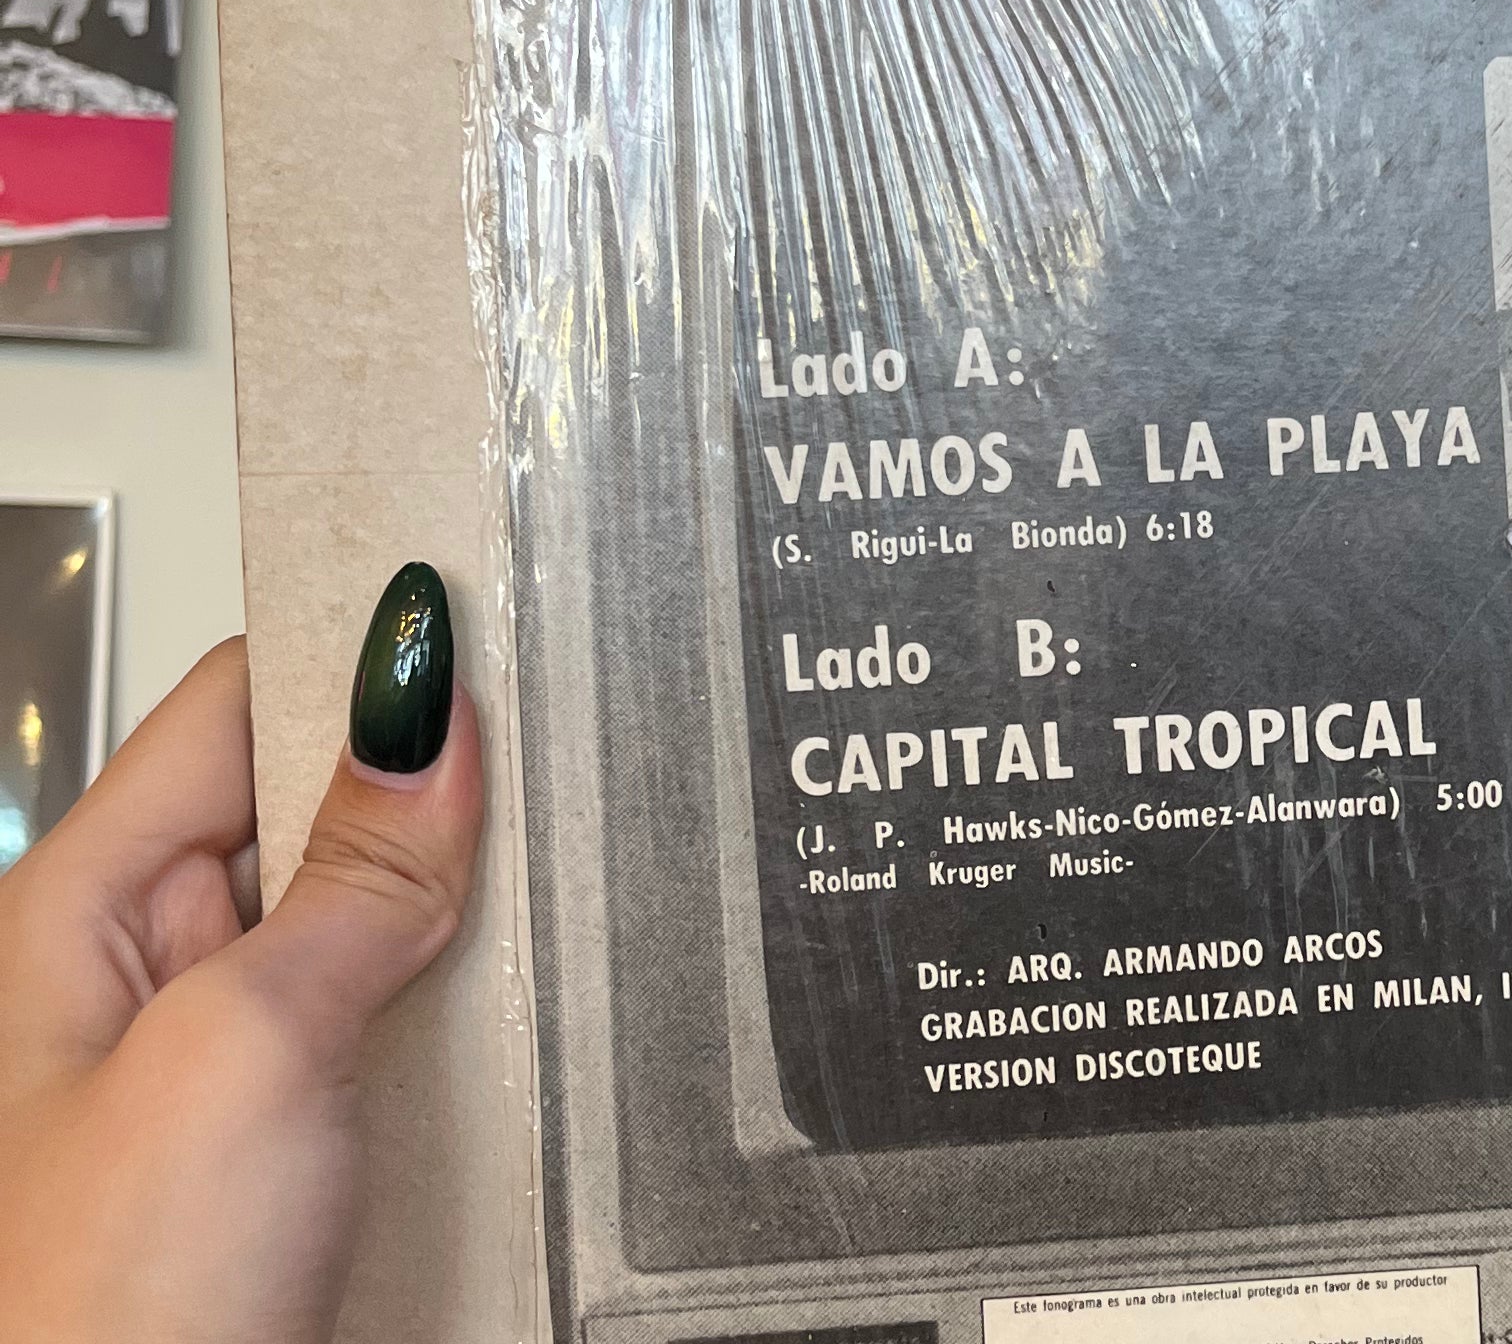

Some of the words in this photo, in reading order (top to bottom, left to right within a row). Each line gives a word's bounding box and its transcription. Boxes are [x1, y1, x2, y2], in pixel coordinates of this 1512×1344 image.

[757, 330, 907, 398] Lado
[954, 327, 1025, 388] A:
[763, 432, 1012, 504] VAMOS
[1057, 428, 1101, 488] A
[1144, 421, 1224, 483] LA
[1267, 406, 1480, 476] PLAYA
[772, 534, 811, 569] (S.
[851, 526, 972, 564] Rigui-La
[1012, 515, 1126, 549] Bionda)
[1146, 510, 1213, 541] 6:18
[782, 624, 931, 692] Lado
[1016, 619, 1081, 677] B:
[791, 721, 1074, 796] CAPITAL
[1113, 698, 1436, 776] TROPICAL
[797, 825, 836, 860] (J.
[875, 821, 905, 848] P.
[944, 787, 1399, 844] Hawks-Nico-Gómez-Alanwara)
[1437, 780, 1502, 811] 5:00
[800, 863, 896, 894] -Roland
[929, 861, 1016, 888] Kruger
[1050, 849, 1133, 877] Music-
[918, 960, 985, 990] Dir.:
[1008, 952, 1082, 983] ARQ.
[1103, 939, 1263, 976] ARMANDO
[1284, 929, 1382, 963] ARCOS
[921, 1001, 1106, 1041] GRABACION
[1126, 988, 1298, 1026] REALIZADA
[1318, 983, 1353, 1012] EN
[1374, 975, 1483, 1009] MILAN,
[924, 1057, 1055, 1092] VERSION
[1076, 1041, 1261, 1081] DISCOTEQUE
[1014, 1301, 1037, 1314] Este
[1108, 1298, 1119, 1307] es
[1126, 1296, 1146, 1306] una
[1152, 1292, 1176, 1304] obra
[1182, 1287, 1241, 1302] intelectual
[1247, 1283, 1299, 1300] protegida
[1305, 1284, 1318, 1294] en
[1324, 1281, 1350, 1293] favor
[1357, 1279, 1370, 1291] de
[1376, 1280, 1387, 1289] su
[1394, 1275, 1447, 1291] productor
